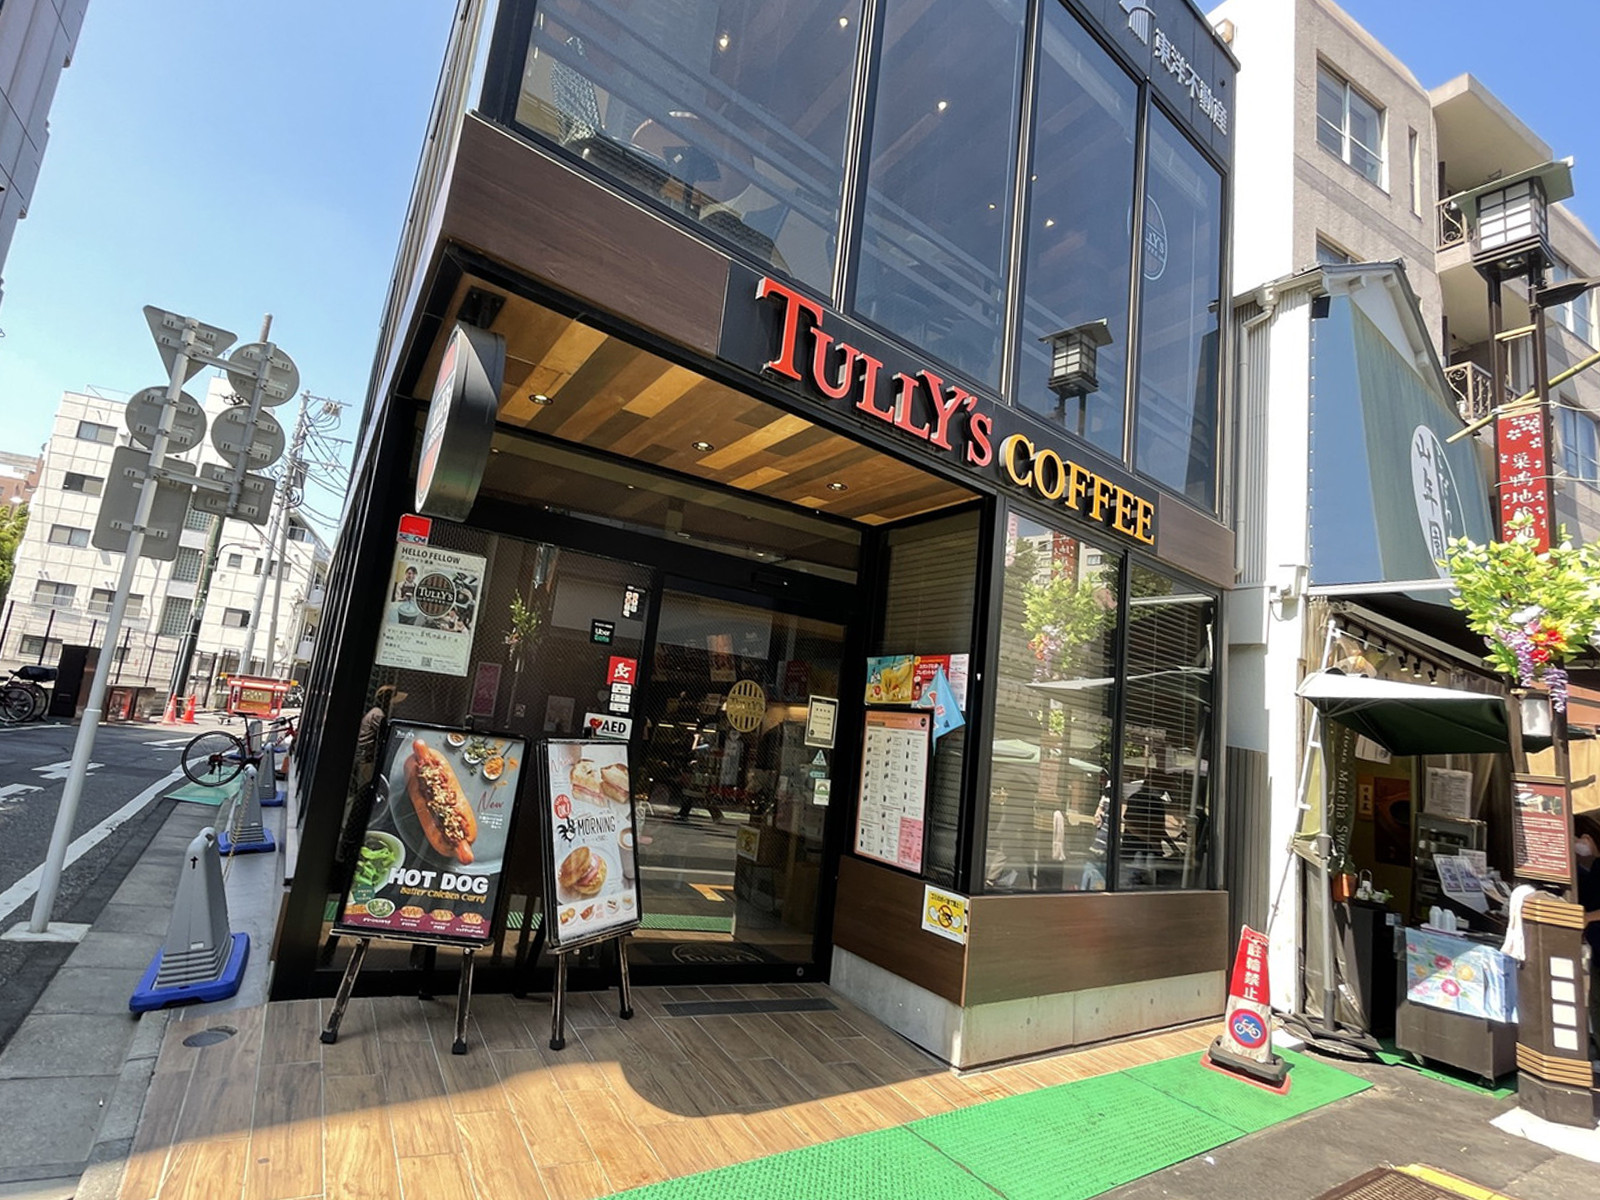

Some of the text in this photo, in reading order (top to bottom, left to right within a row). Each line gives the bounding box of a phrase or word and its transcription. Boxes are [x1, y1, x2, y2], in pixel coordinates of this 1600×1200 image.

[1154, 27, 1228, 136] 東洋不動産
[755, 276, 1156, 546] TULLY'S COFFEE
[401, 547, 461, 564] HELLO FELLOW
[419, 587, 454, 601] TULLY'S
[595, 627, 611, 636] Uber
[601, 719, 627, 734] AED
[1336, 769, 1349, 819] Matcha
[577, 815, 616, 837] MORNING
[388, 867, 489, 895] HOT DOG
[1242, 942, 1262, 1001] 駐輪禁止
